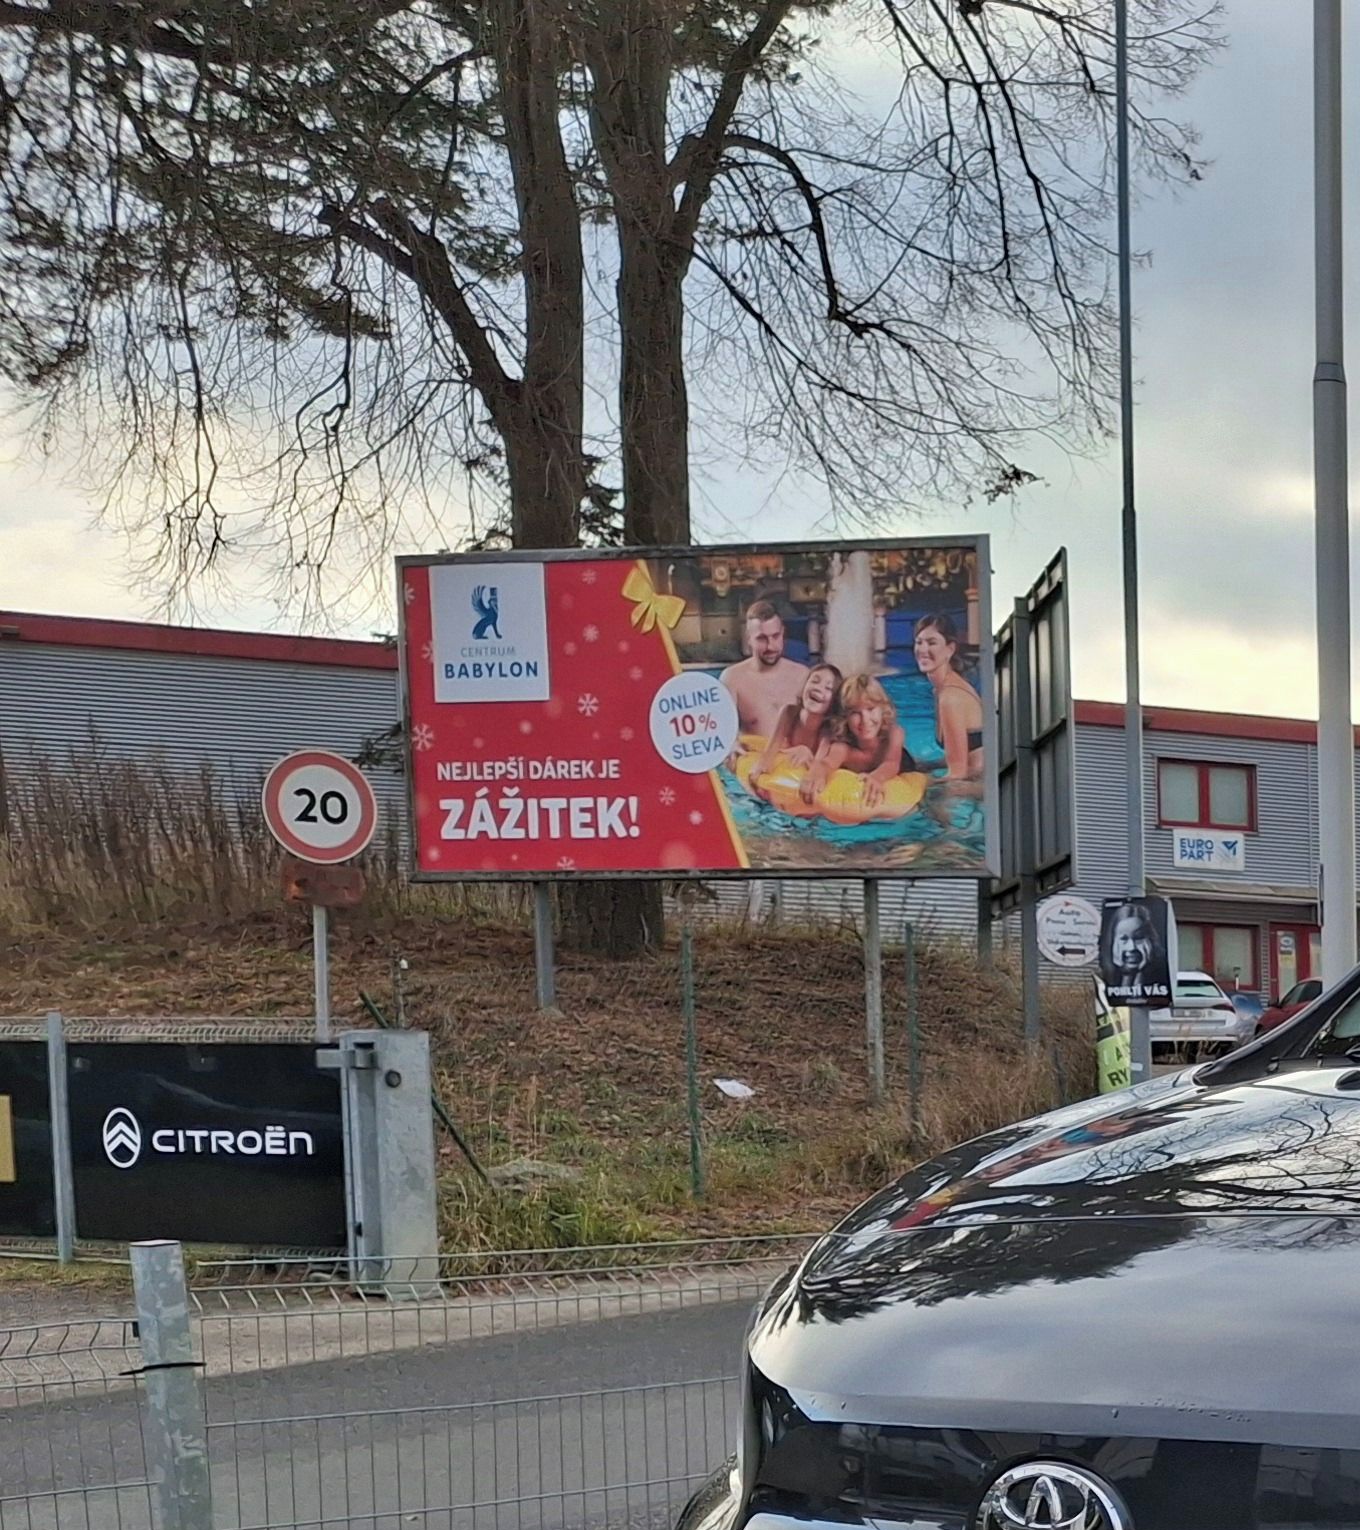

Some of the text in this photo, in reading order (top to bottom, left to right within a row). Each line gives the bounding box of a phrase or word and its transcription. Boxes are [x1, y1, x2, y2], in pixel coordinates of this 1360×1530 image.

[460, 646, 516, 657] CENTRUM
[444, 661, 538, 679] BABYLON
[658, 686, 721, 714] ONLINE
[672, 735, 725, 760] SLEVA
[436, 756, 621, 781] NEJLEPŠÍ DÁREK JE
[293, 788, 348, 825] 20
[438, 785, 641, 840] ZÁŽITEK!
[1180, 838, 1214, 850] EURO
[1180, 849, 1214, 862] PART
[1143, 983, 1169, 996] VÁS
[152, 1126, 314, 1155] CITROËN
